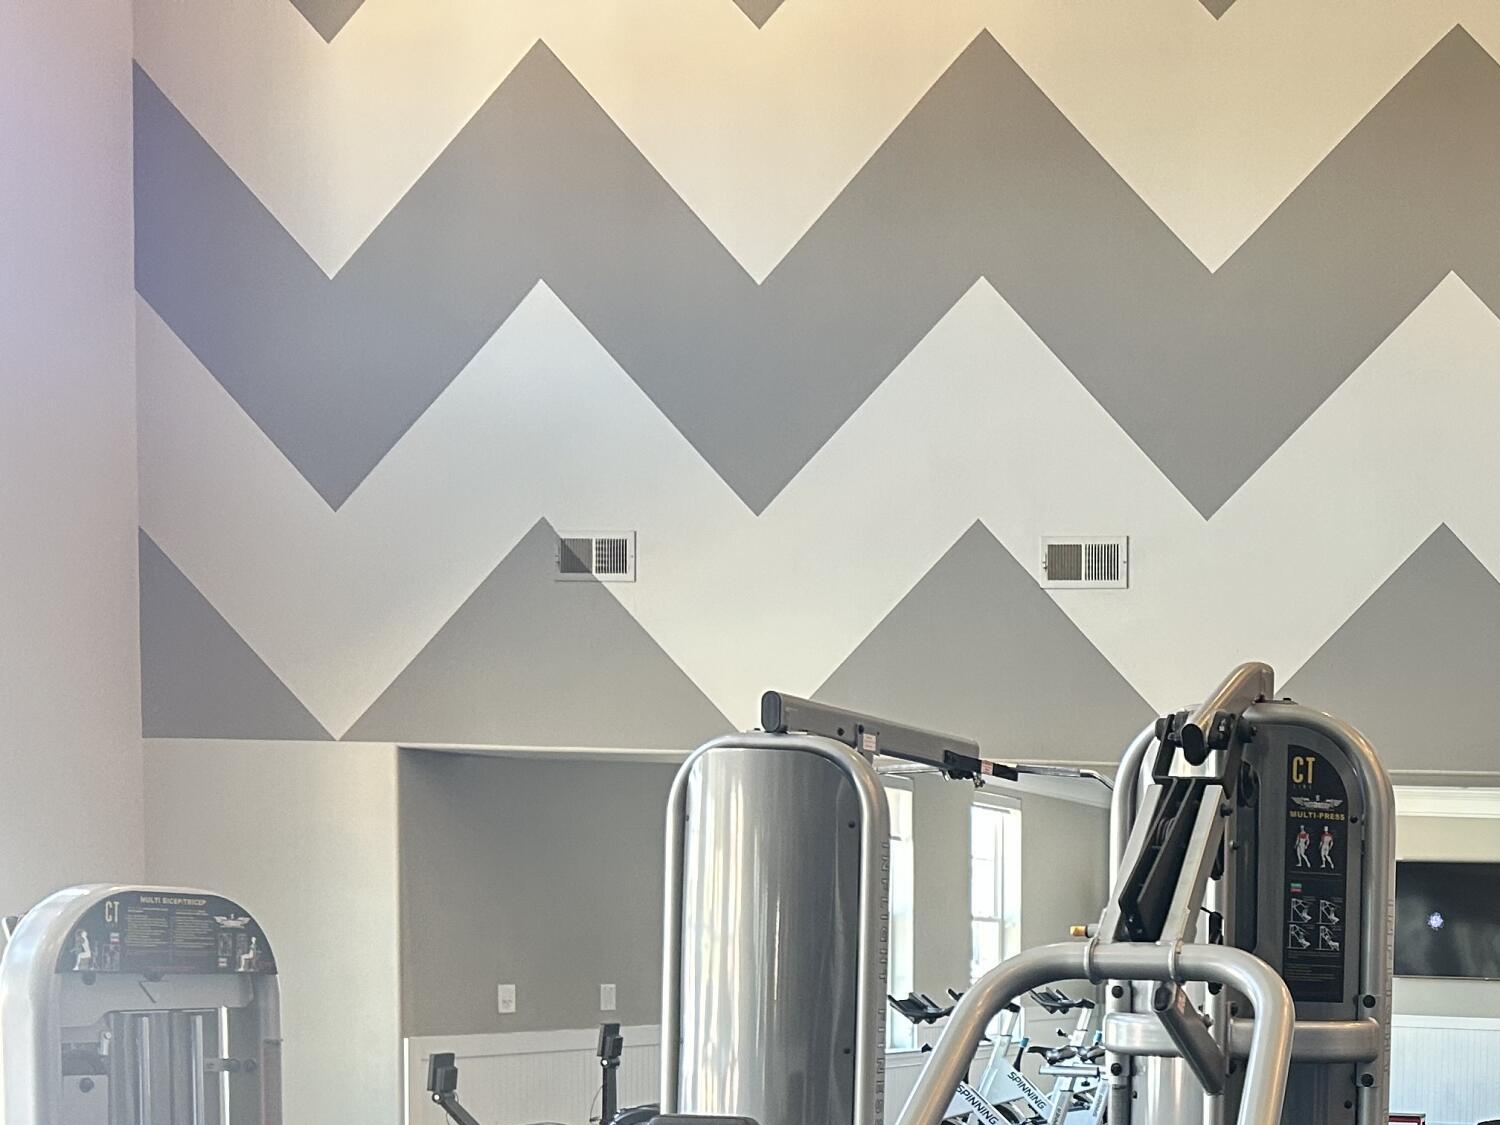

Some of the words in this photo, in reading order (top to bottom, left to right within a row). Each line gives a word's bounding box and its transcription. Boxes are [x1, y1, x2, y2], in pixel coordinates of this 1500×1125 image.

[1292, 756, 1316, 784] CT
[105, 901, 120, 923] CT
[956, 1084, 1000, 1125] SPINNING
[1007, 1071, 1047, 1111] SPINNING
